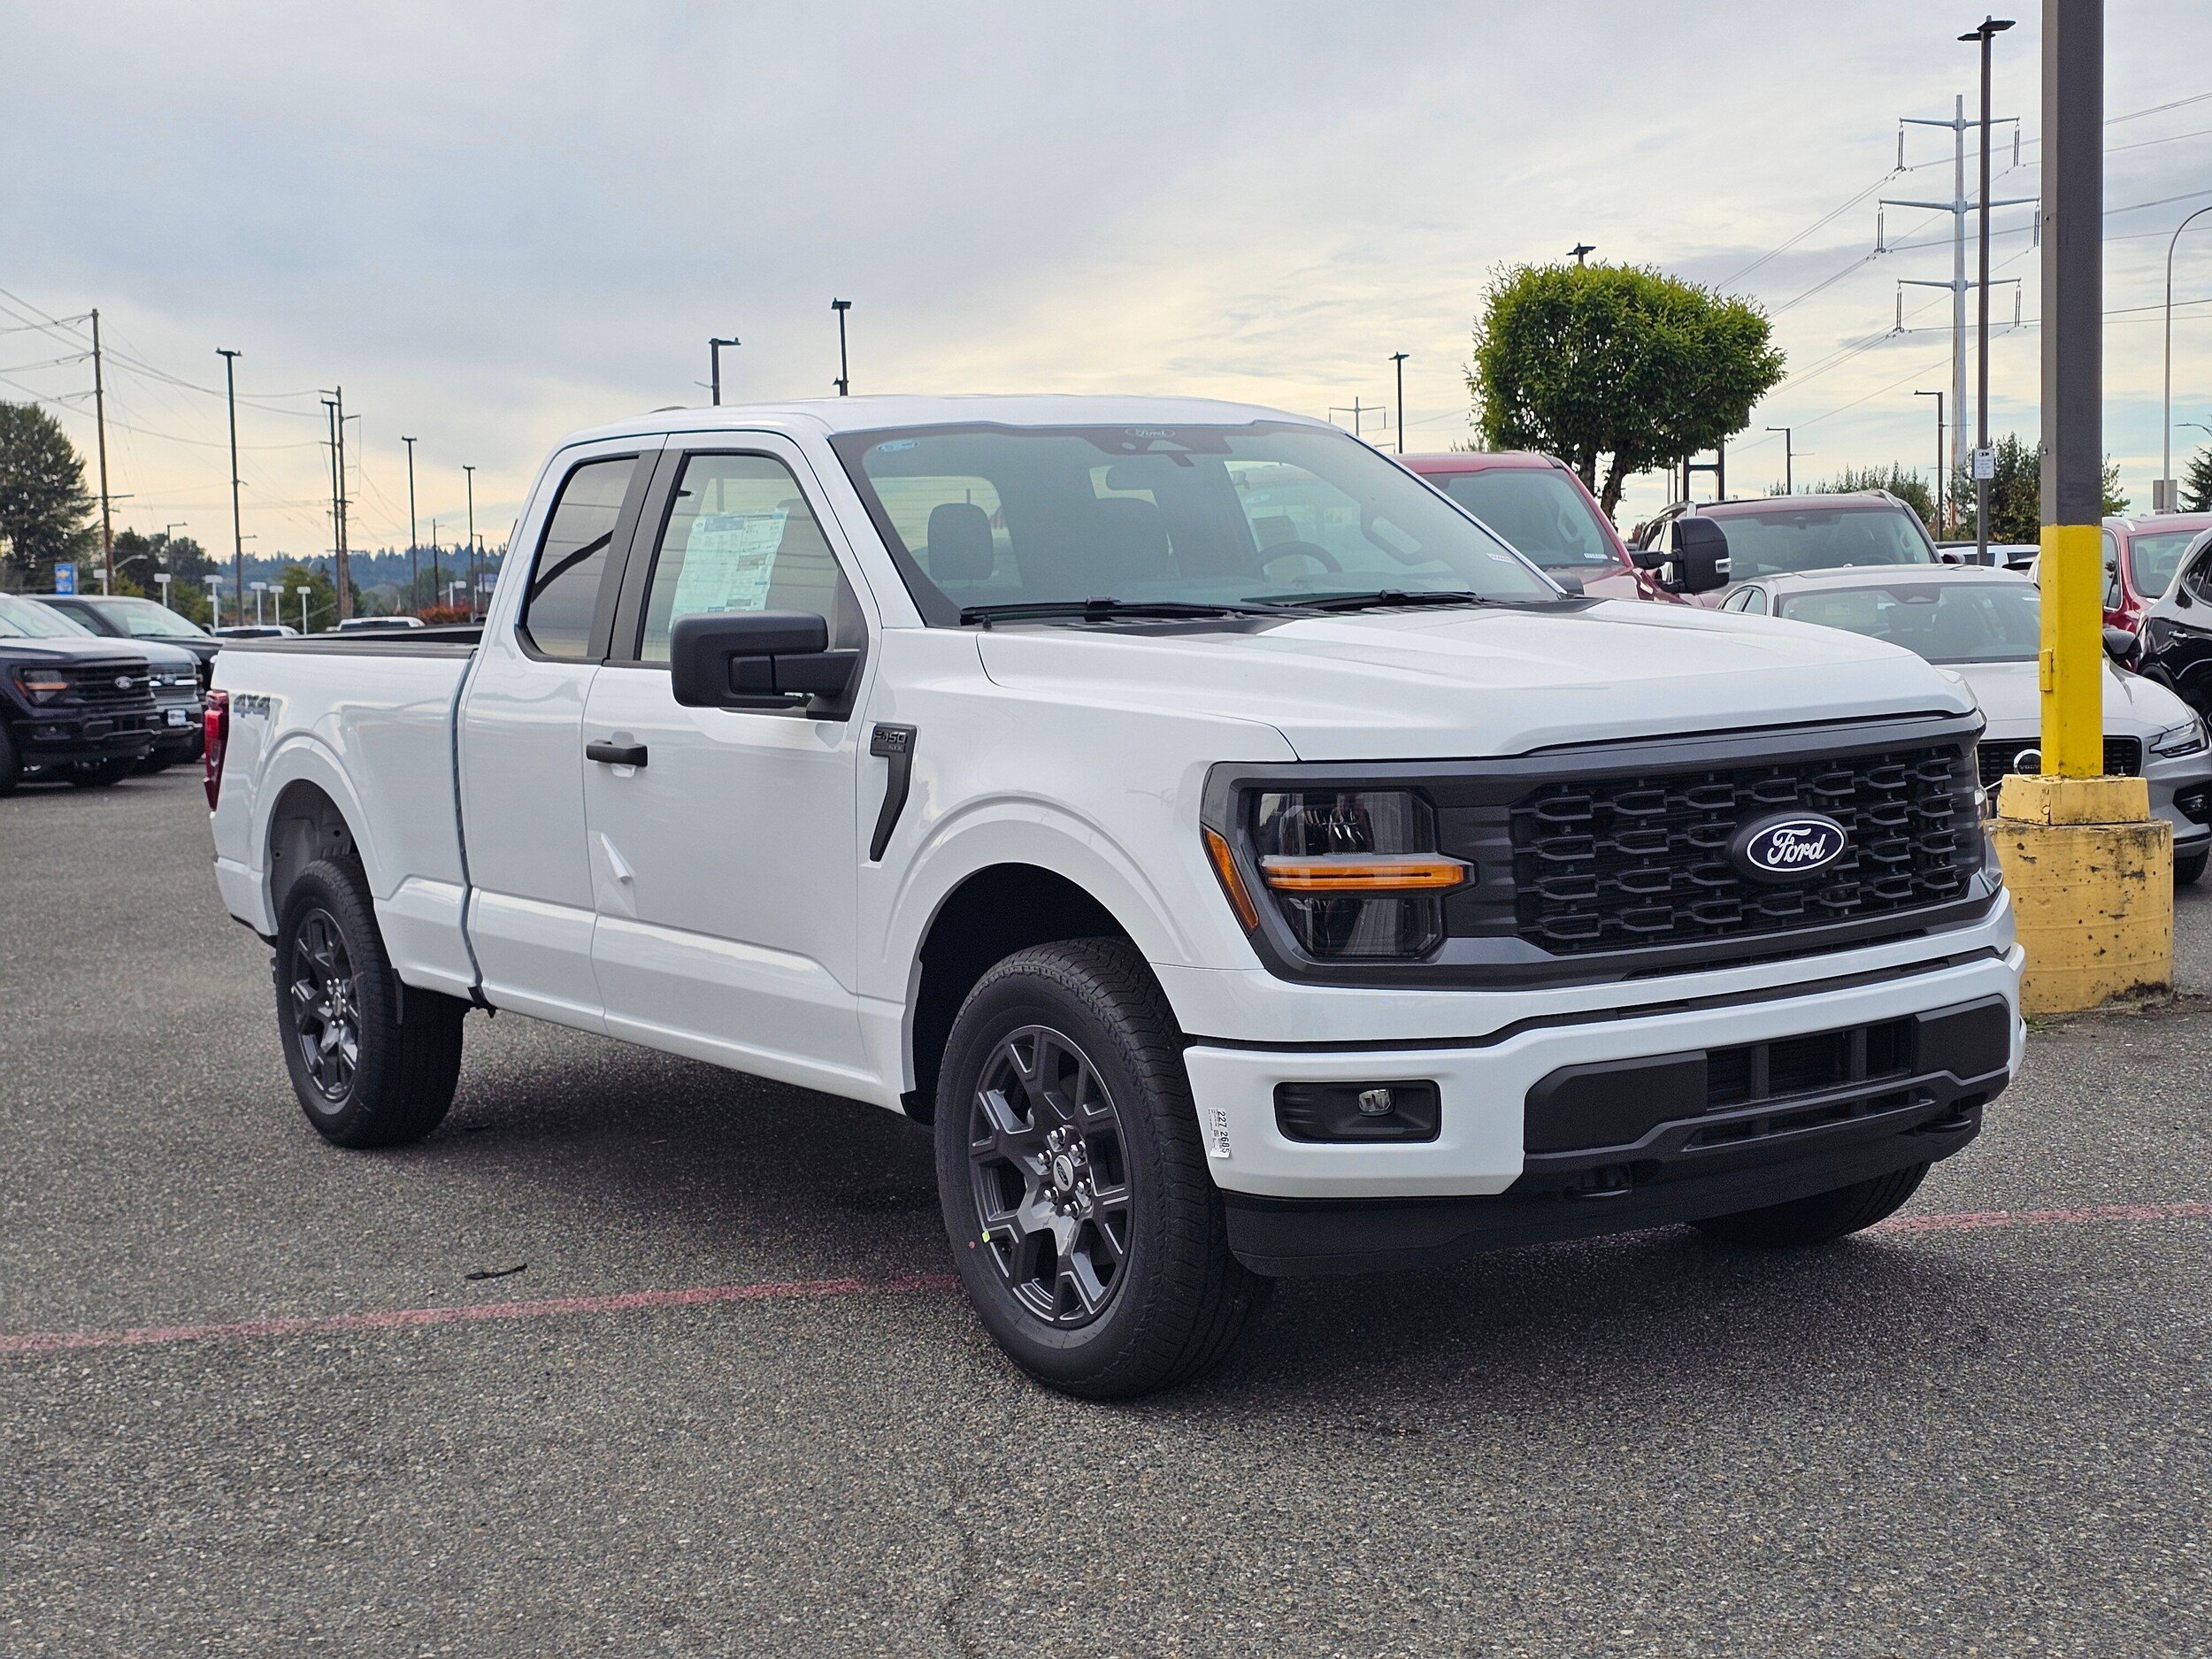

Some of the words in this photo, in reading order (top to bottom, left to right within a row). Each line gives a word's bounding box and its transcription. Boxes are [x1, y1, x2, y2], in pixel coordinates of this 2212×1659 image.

[873, 730, 908, 743] F-150
[1766, 827, 1827, 865] Ford
[1217, 1110, 1227, 1128] 227
